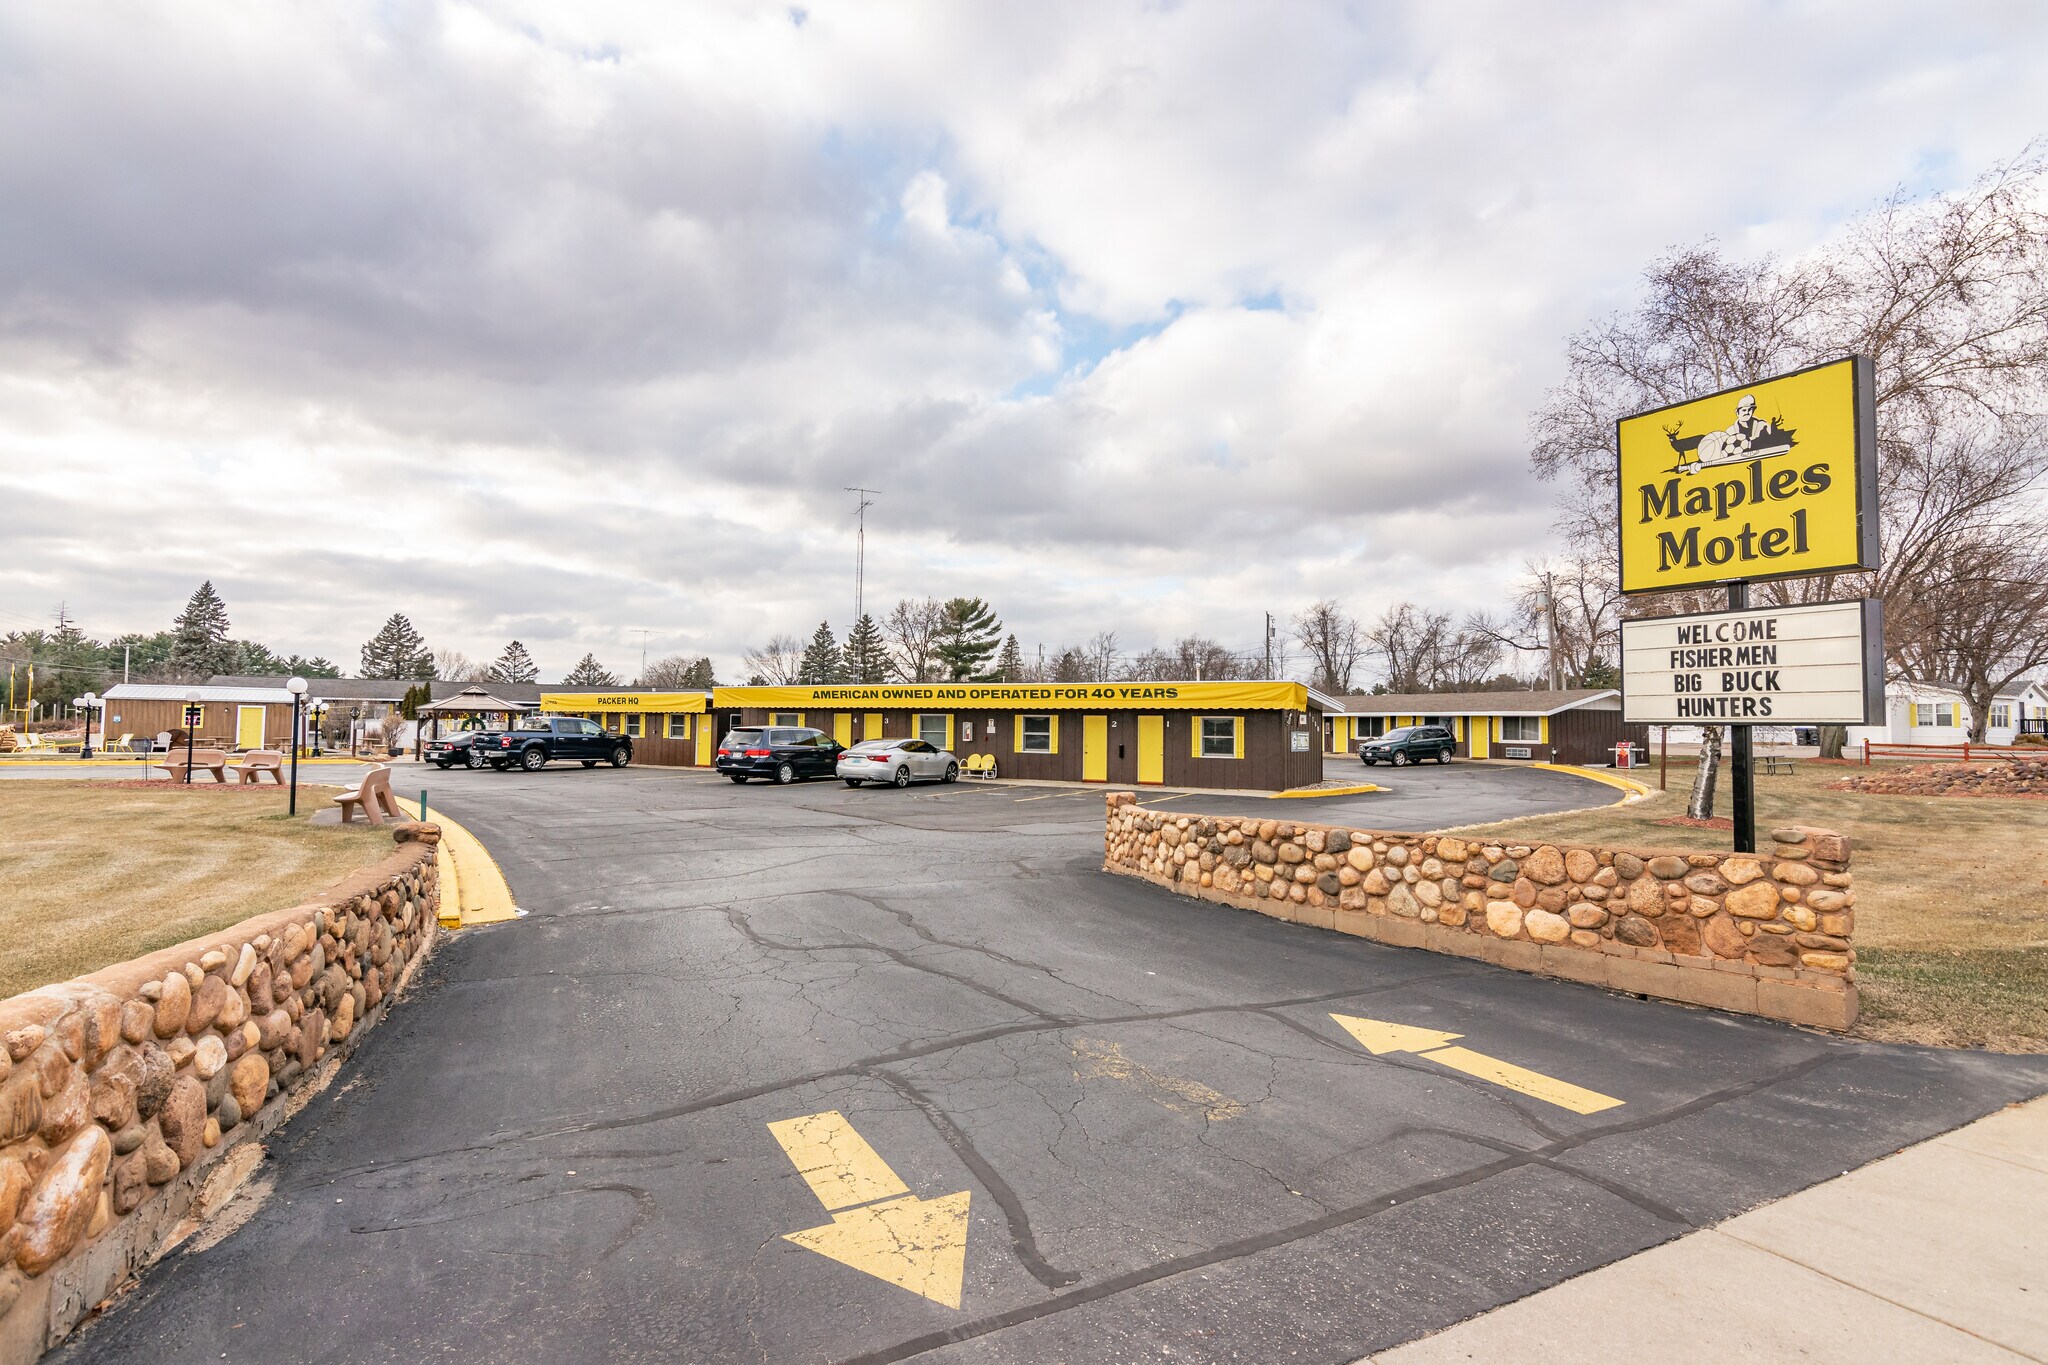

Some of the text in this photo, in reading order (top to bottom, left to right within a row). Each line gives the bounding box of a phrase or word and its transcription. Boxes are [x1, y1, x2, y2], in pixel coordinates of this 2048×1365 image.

[1638, 461, 1832, 524] Maples
[1656, 509, 1810, 573] Motel
[1677, 618, 1777, 645] WELCOME
[1670, 644, 1777, 669] FISHERMEN
[812, 687, 1179, 699] AMERICAN OWNED AND OPERATED FOR 40 YEARS
[1674, 670, 1781, 693] BIG BUCK
[597, 697, 639, 705] PACKER HQ
[1676, 696, 1772, 718] HUNTERS
[1111, 720, 1118, 728] 2
